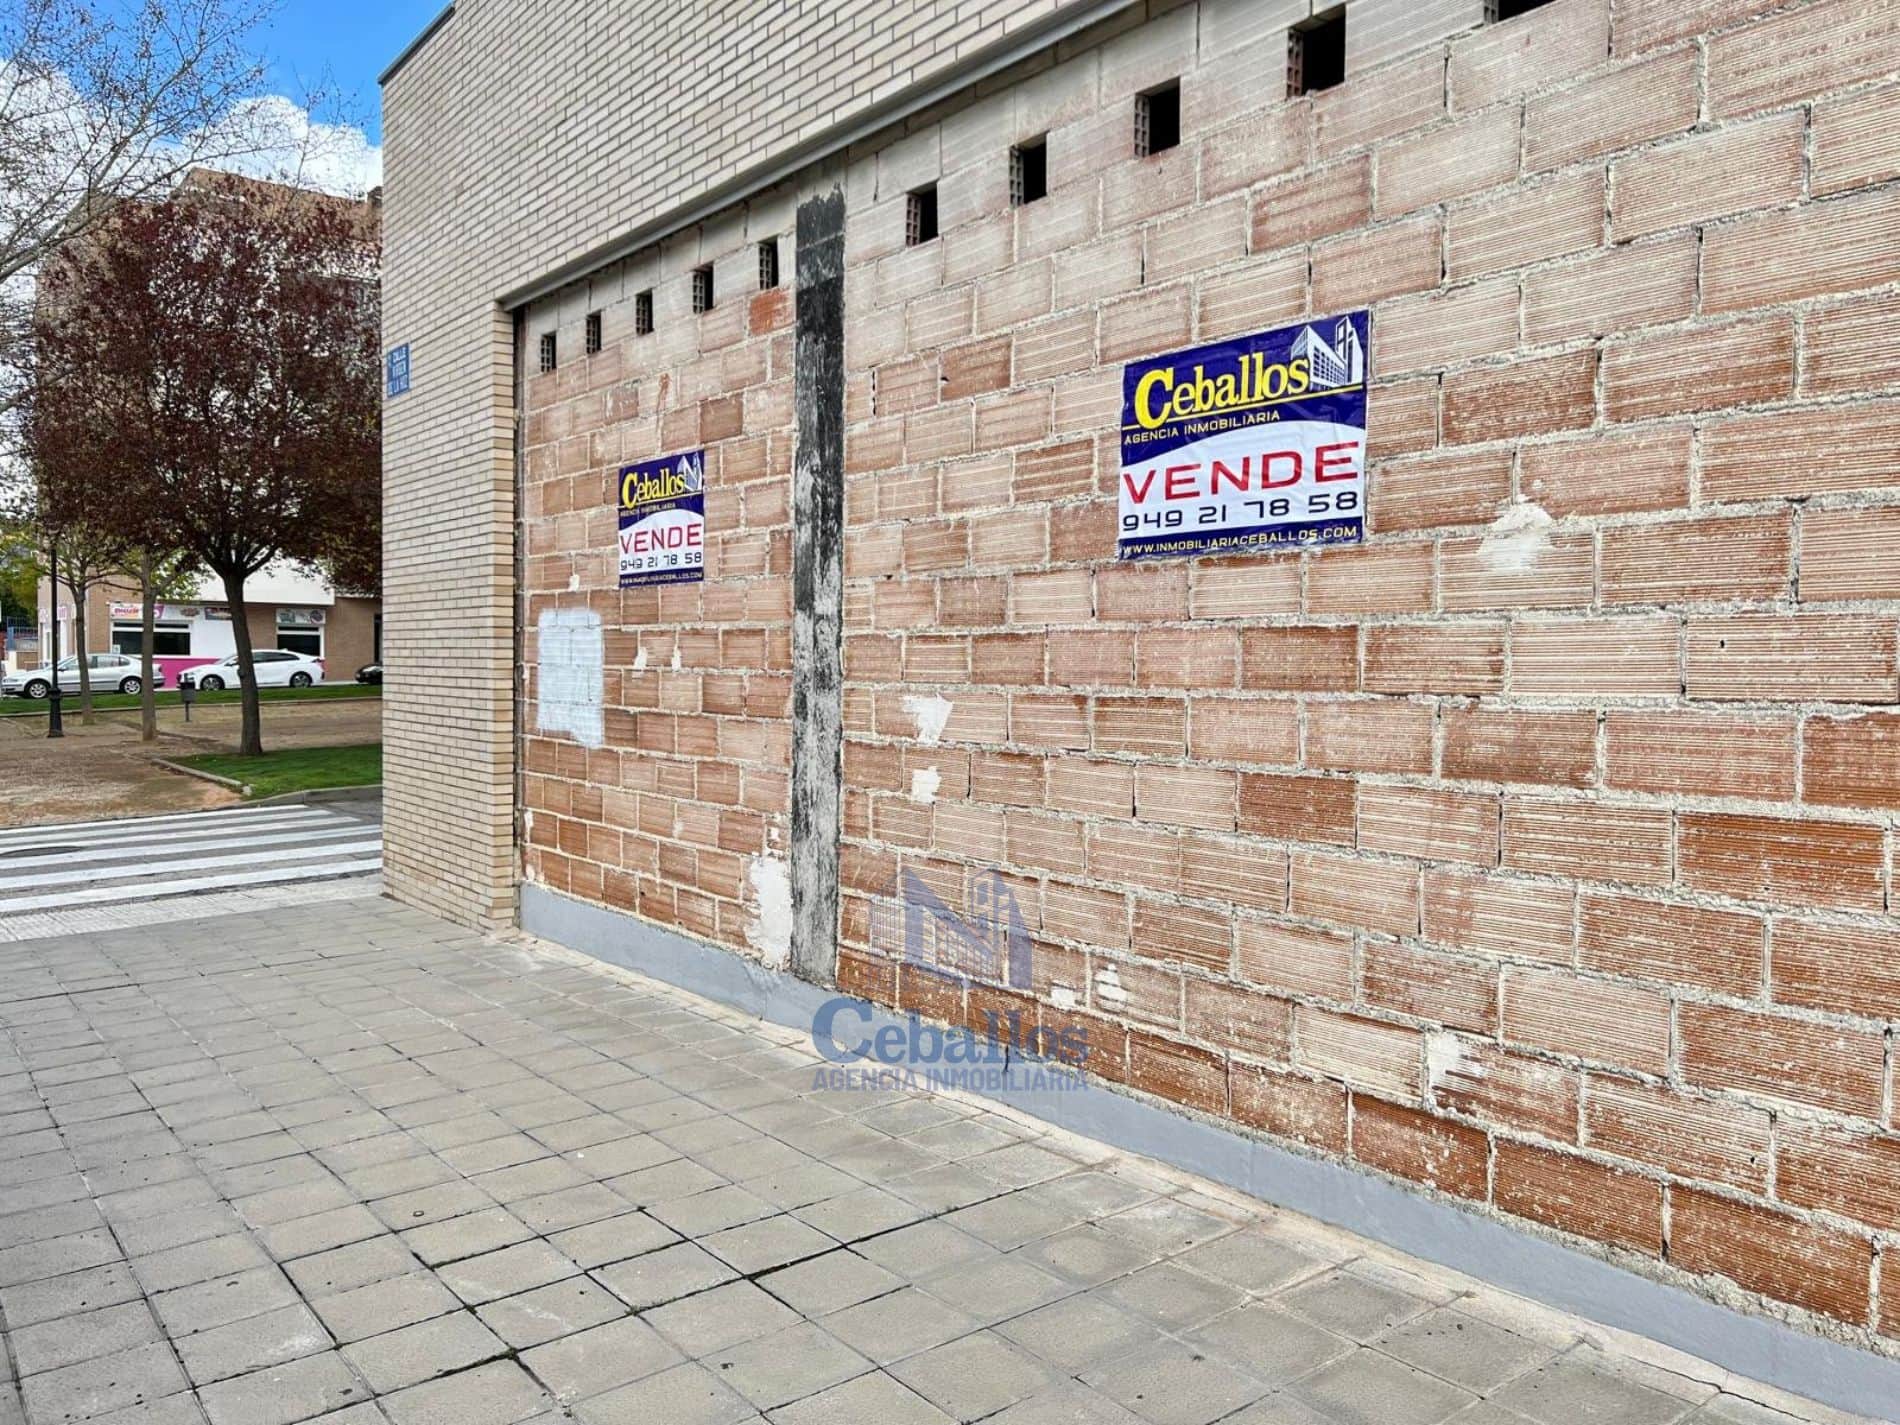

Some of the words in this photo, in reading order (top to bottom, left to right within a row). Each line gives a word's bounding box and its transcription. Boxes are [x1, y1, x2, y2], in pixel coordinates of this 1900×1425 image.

[1135, 352, 1310, 430] Ceballos
[1123, 427, 1179, 445] AGENCIA
[1184, 410, 1281, 434] INMOBILIARIA
[622, 468, 685, 508] Ceballos
[1123, 441, 1360, 505] VENDE
[1122, 510, 1183, 532] 949
[1198, 505, 1227, 524] 21
[1244, 499, 1290, 519] 78
[1308, 492, 1358, 514] 58
[620, 523, 702, 554] VENDE
[1122, 526, 1357, 554] WWW.INMOBILIARIACEBALLOS.COM
[647, 556, 658, 568] 21
[663, 554, 678, 566] 78
[684, 552, 702, 564] 58
